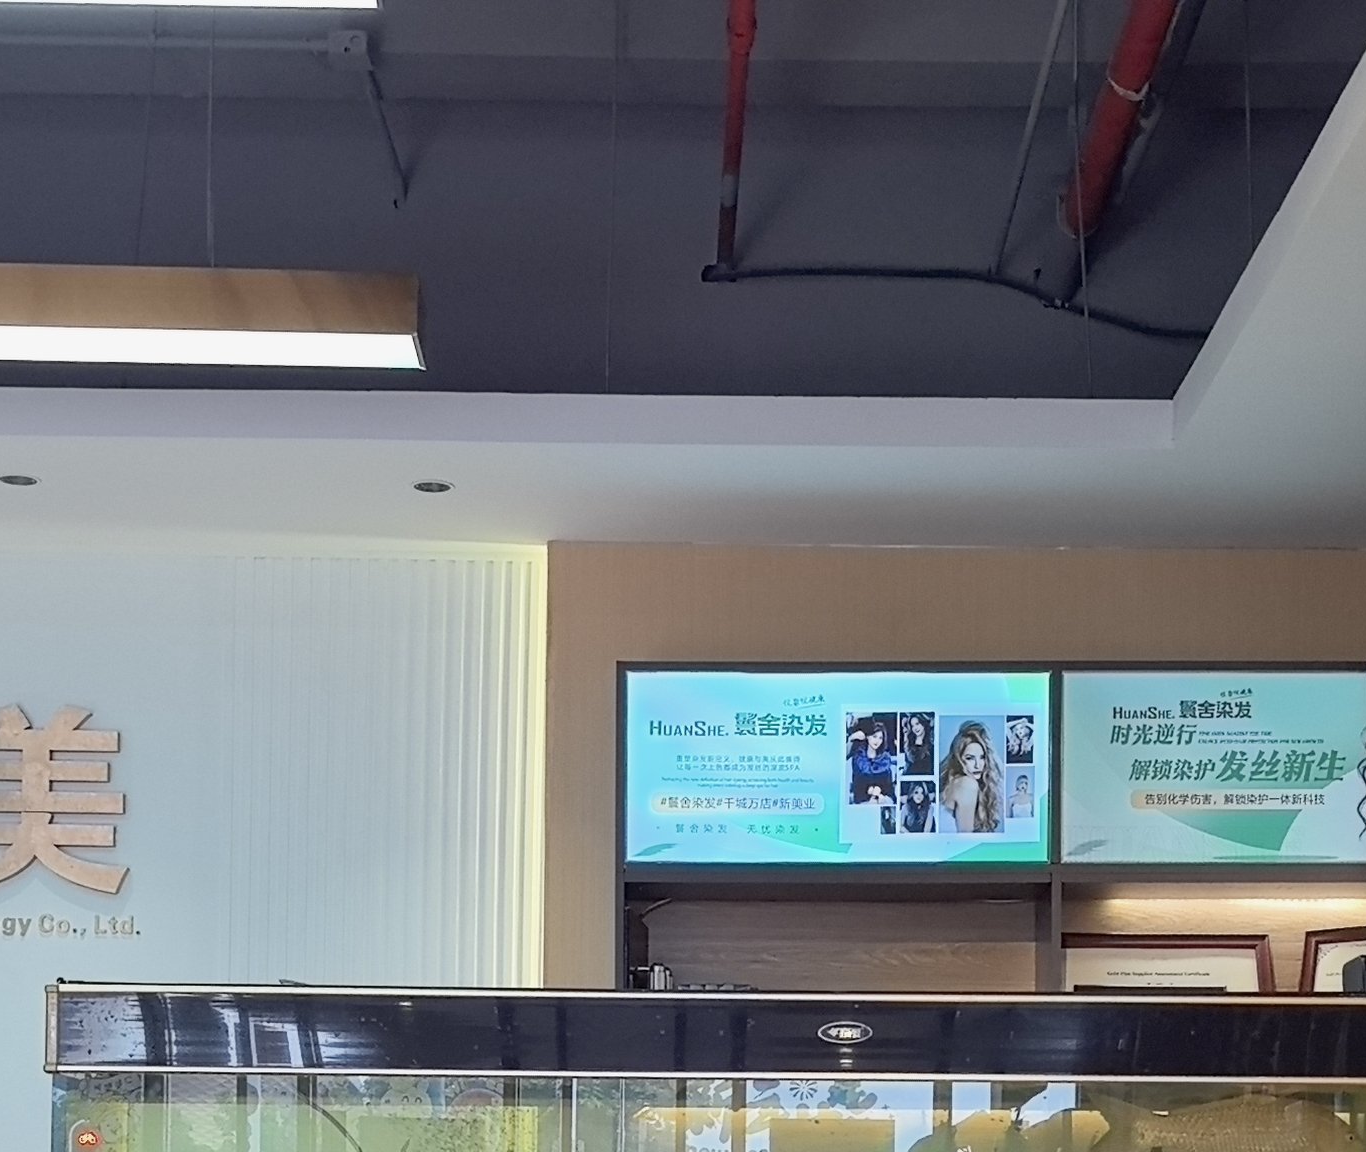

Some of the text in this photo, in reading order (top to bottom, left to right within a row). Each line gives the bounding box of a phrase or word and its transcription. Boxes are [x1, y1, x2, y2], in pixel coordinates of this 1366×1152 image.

[1110, 723, 1198, 746] 时光逆行
[1216, 750, 1347, 782] 发丝新生
[38, 912, 86, 938] Co.,
[93, 913, 141, 936] Ltd.
